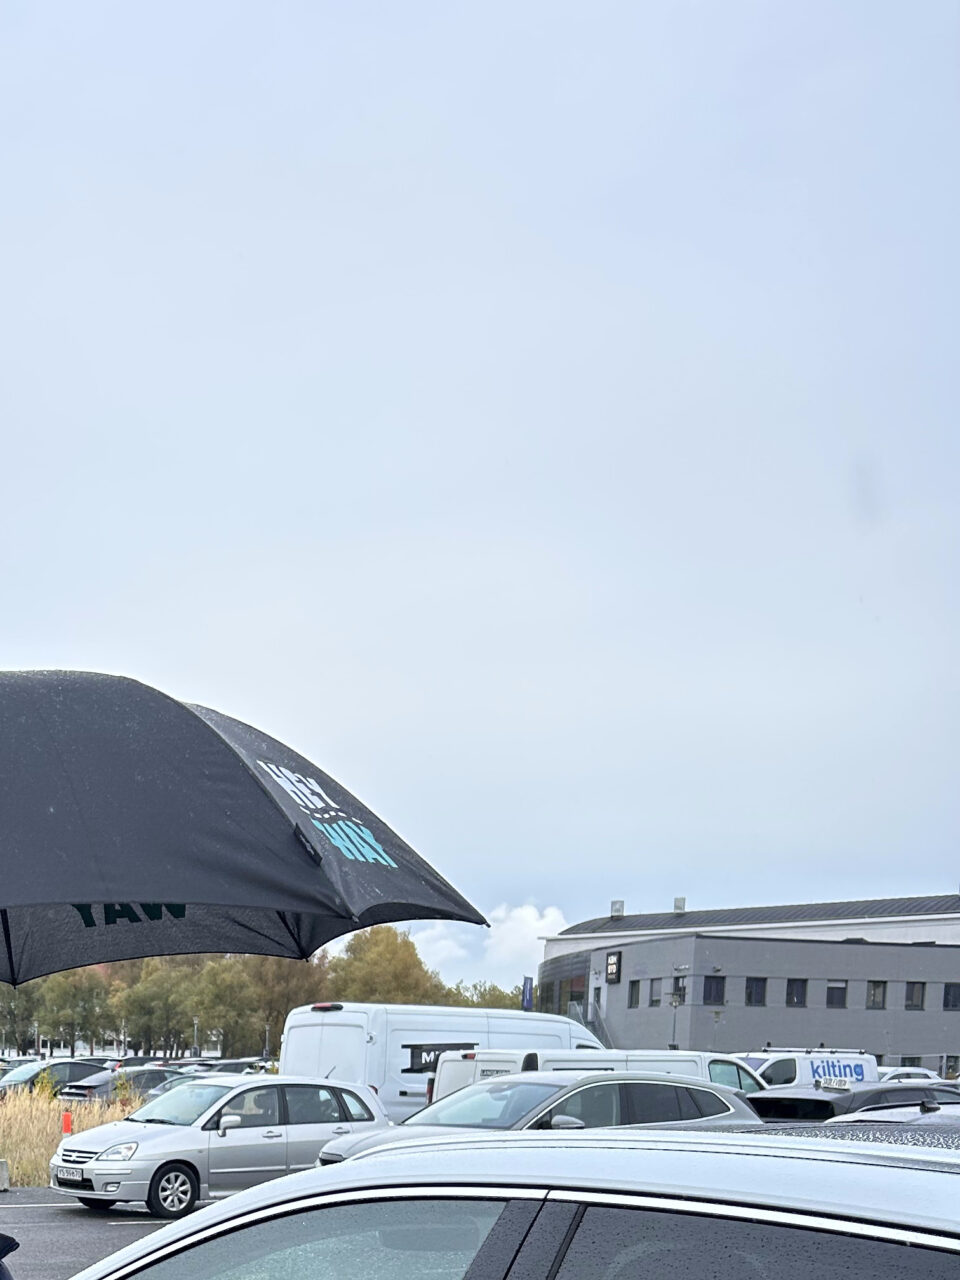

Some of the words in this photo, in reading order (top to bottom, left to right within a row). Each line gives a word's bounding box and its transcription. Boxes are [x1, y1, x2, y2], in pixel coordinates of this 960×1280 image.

[256, 759, 341, 809] HEY
[309, 820, 399, 869] WAY
[810, 1059, 865, 1082] kilting
